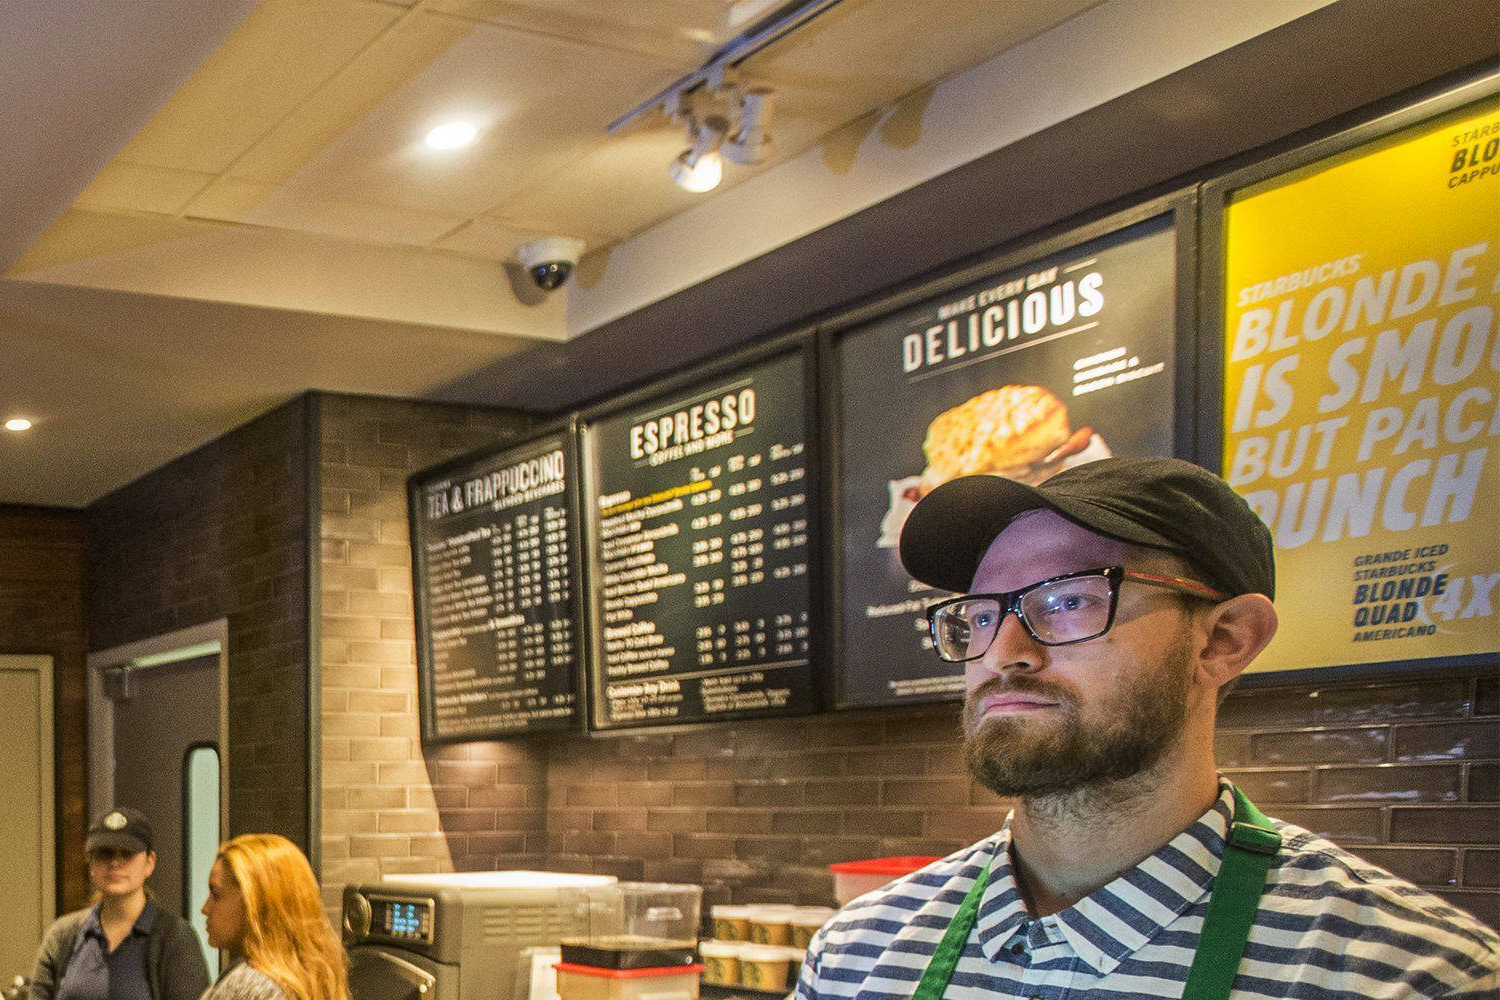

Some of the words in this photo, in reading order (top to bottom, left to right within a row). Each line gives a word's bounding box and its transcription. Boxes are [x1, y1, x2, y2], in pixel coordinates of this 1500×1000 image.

[978, 277, 1025, 308] EVERY
[1025, 265, 1060, 291] DAY
[1230, 241, 1489, 363] BLONDE
[1236, 252, 1364, 308] STARBUCKS
[902, 272, 1105, 373] DELICIOUS
[1231, 354, 1300, 433] IS
[1316, 305, 1500, 414] SMO
[630, 388, 757, 460] ESPRESSO
[649, 444, 685, 467] COFFEE
[684, 437, 705, 456] AND
[704, 430, 735, 450] MORE
[1229, 416, 1349, 488] BUT
[1356, 387, 1500, 462] PAC
[427, 491, 450, 520] TEA
[451, 486, 465, 514] &
[464, 450, 565, 510] FRAPPUCCINO
[1355, 548, 1412, 567] GRANDE
[1413, 543, 1449, 558] ICED
[1355, 560, 1437, 581] STARBUCKS
[1353, 573, 1449, 605] BLONDE
[1353, 624, 1437, 641] AMERICANO
[1354, 601, 1420, 627] QUAD
